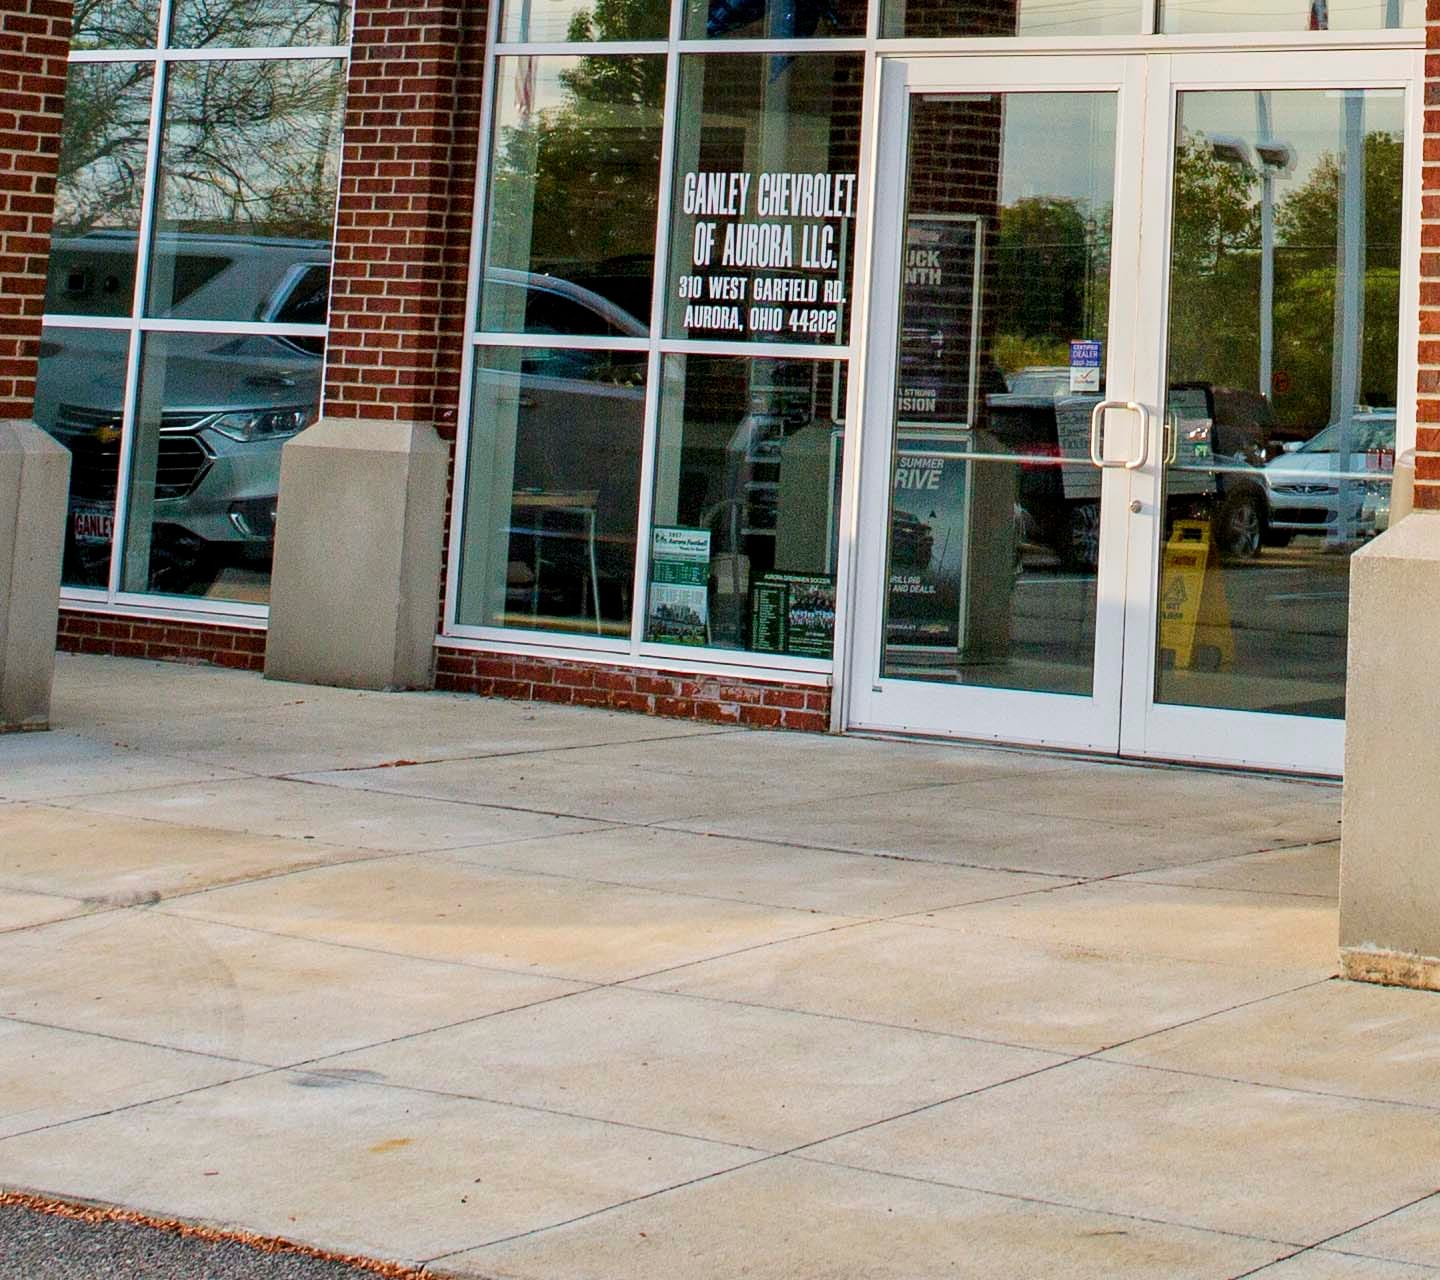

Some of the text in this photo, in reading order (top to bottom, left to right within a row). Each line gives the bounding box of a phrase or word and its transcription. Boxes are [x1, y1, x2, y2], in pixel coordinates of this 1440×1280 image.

[683, 171, 856, 218] GANLEY CHEVROLET
[693, 221, 838, 269] OF AURORA LLC.
[905, 249, 941, 267] UCK
[904, 267, 942, 285] NTH
[679, 275, 847, 304] 310 WEST GARFIELD RD.
[683, 304, 837, 333] AURORA, OHIO 44202
[898, 397, 936, 412] ISION
[899, 456, 944, 469] SUMMER
[894, 468, 942, 490] RIVE
